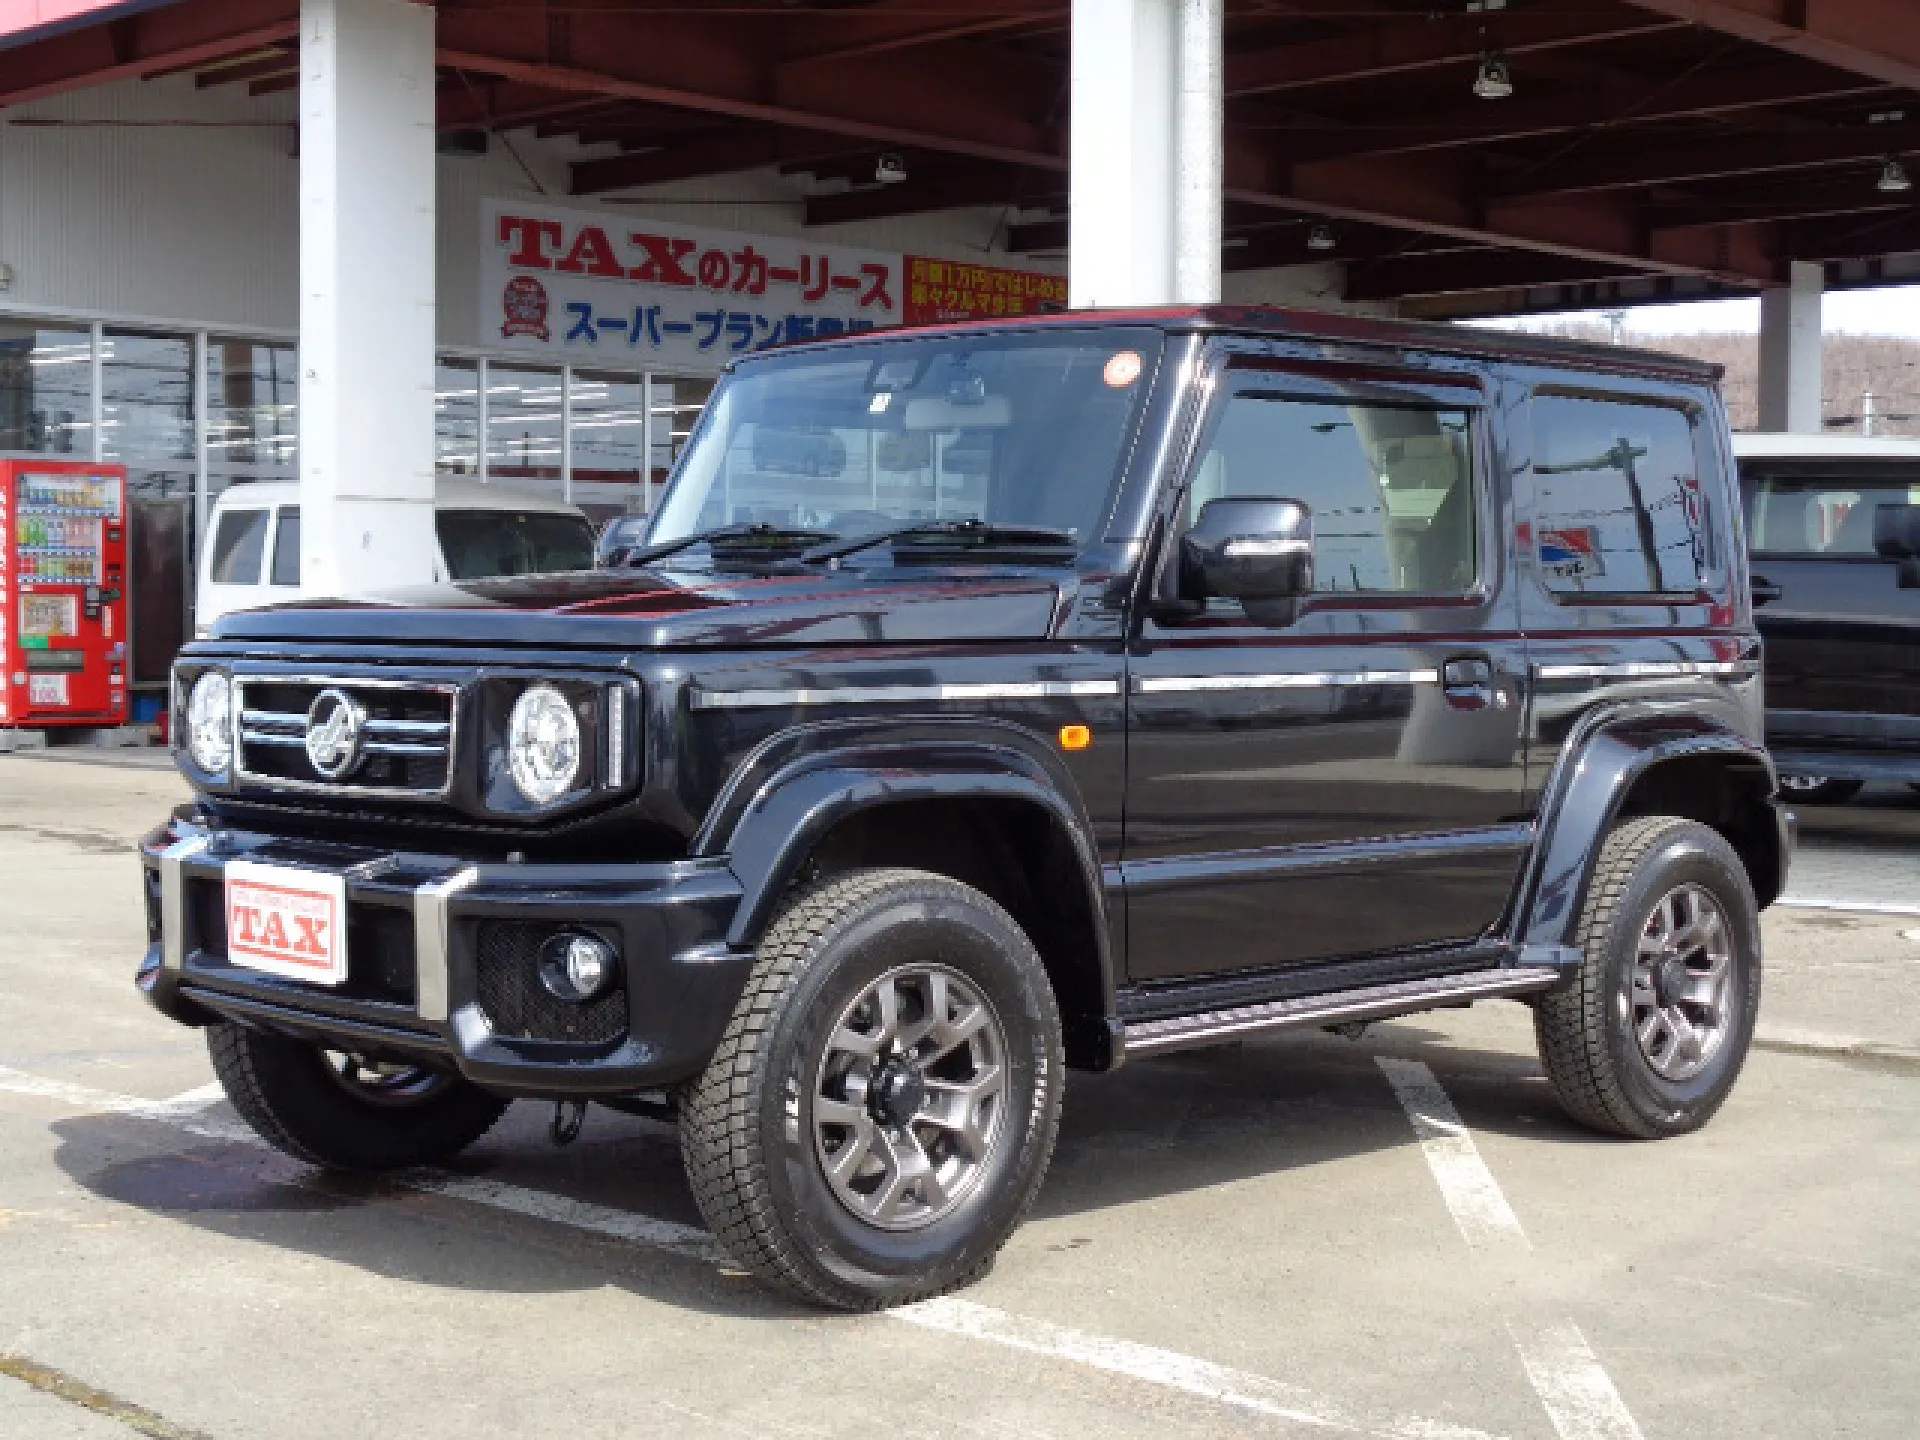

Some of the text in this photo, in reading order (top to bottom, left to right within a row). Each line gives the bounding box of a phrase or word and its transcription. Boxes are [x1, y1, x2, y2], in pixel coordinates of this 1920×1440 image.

[499, 214, 893, 310] TAXのカーリース
[234, 906, 328, 955] TAX
